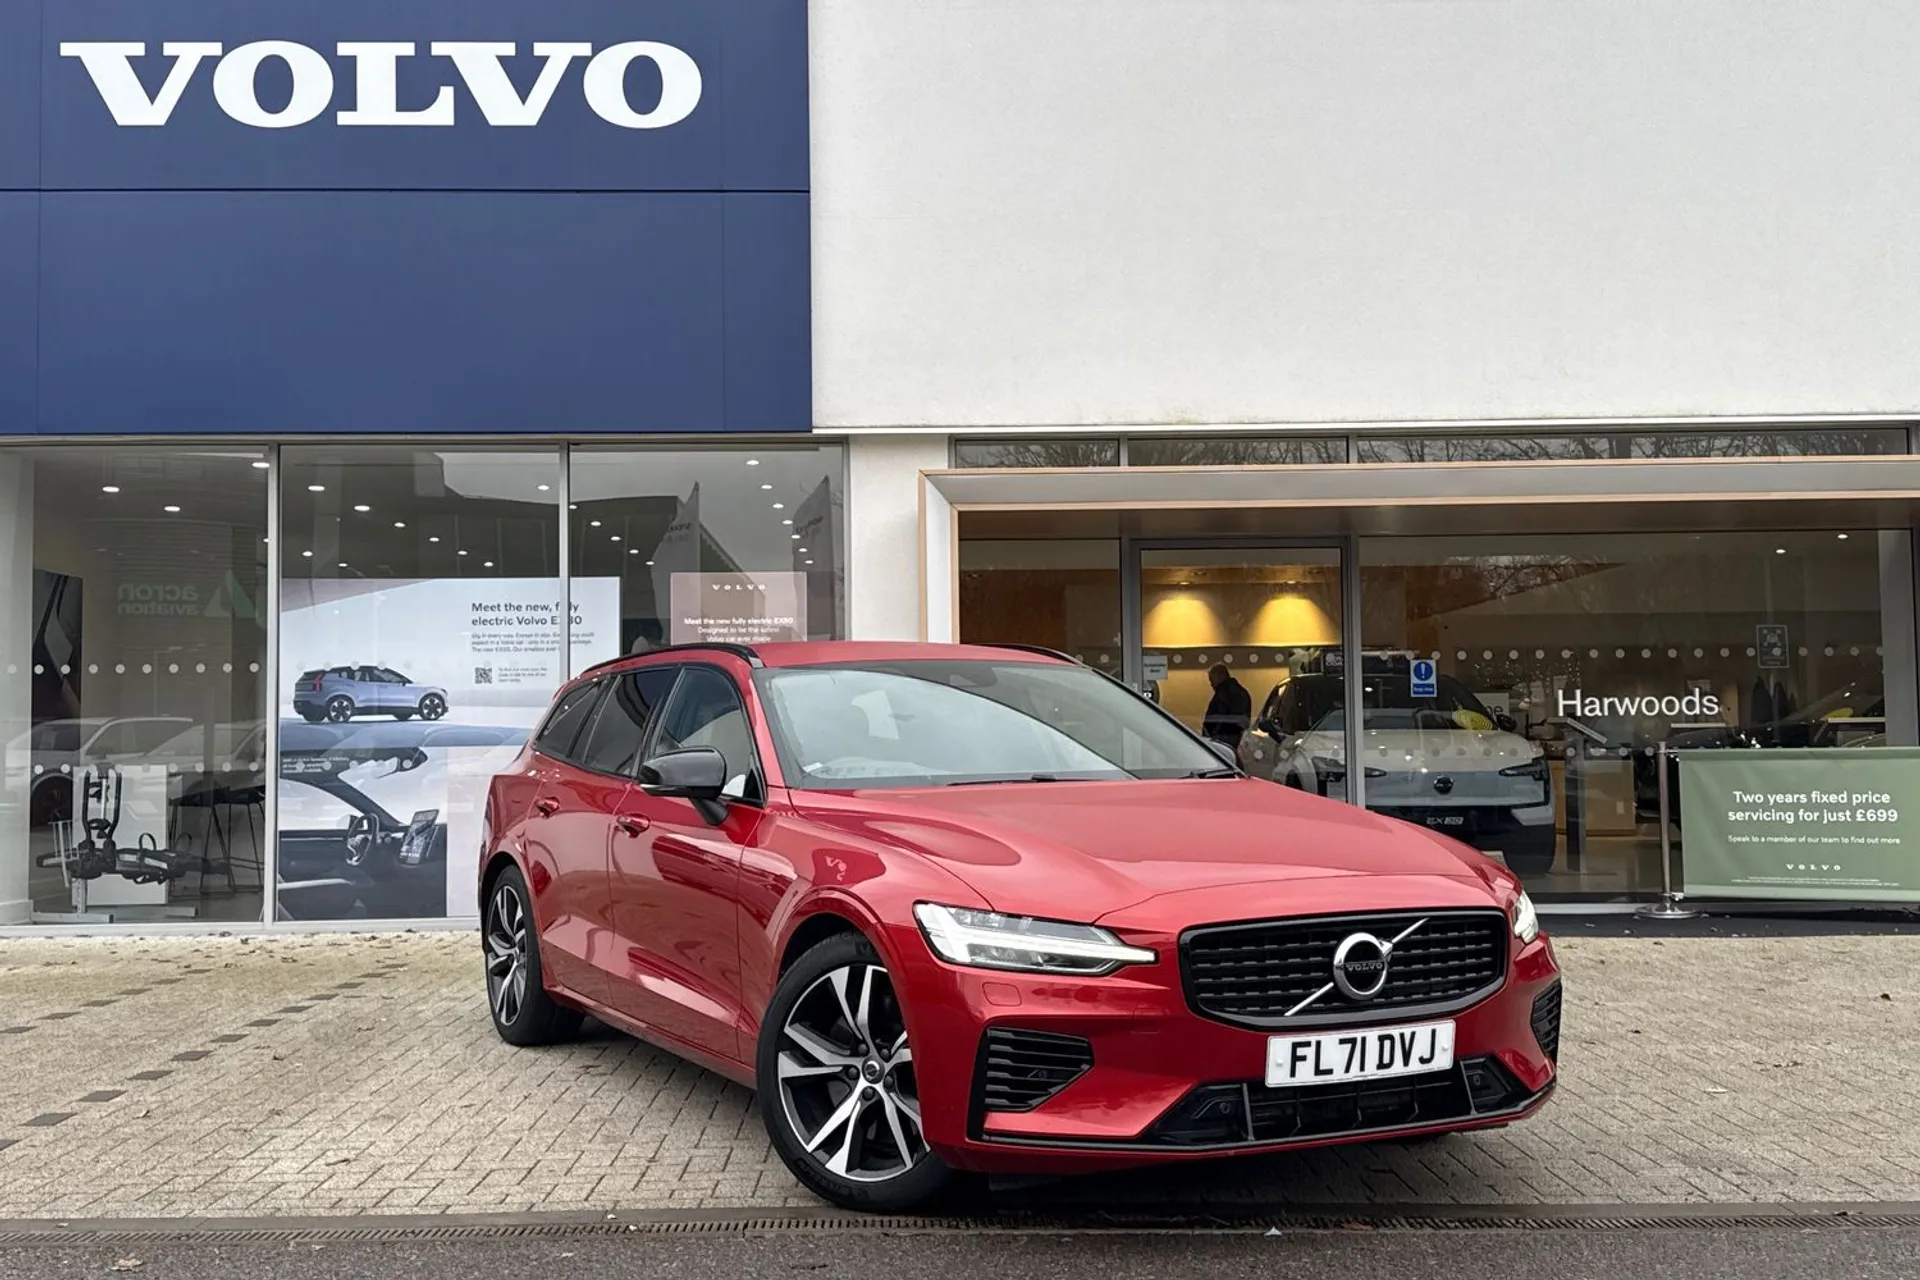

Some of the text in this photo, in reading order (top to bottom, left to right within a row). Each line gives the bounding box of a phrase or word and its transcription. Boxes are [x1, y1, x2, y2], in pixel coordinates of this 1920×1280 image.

[59, 40, 702, 129] VOLVO
[471, 601, 579, 613] Meet the new, fly
[471, 615, 583, 626] electric Volvo E30
[684, 617, 702, 625] Meet
[703, 617, 714, 625] the
[1558, 687, 1719, 717] Harwoods
[1733, 790, 1891, 806] Two years fixed price
[1728, 808, 1899, 824] servicing for just £699
[1728, 834, 1750, 844] Speak
[1767, 835, 1797, 843] member
[1798, 835, 1806, 843] of
[1821, 836, 1840, 844] team
[1841, 836, 1850, 844] to
[1850, 835, 1865, 844] find
[1866, 836, 1879, 844] out
[1880, 837, 1901, 845] more
[1786, 863, 1841, 871] VOLVO
[1346, 962, 1383, 971] VOLVO
[1289, 1029, 1436, 1078] FL71 DVJ
